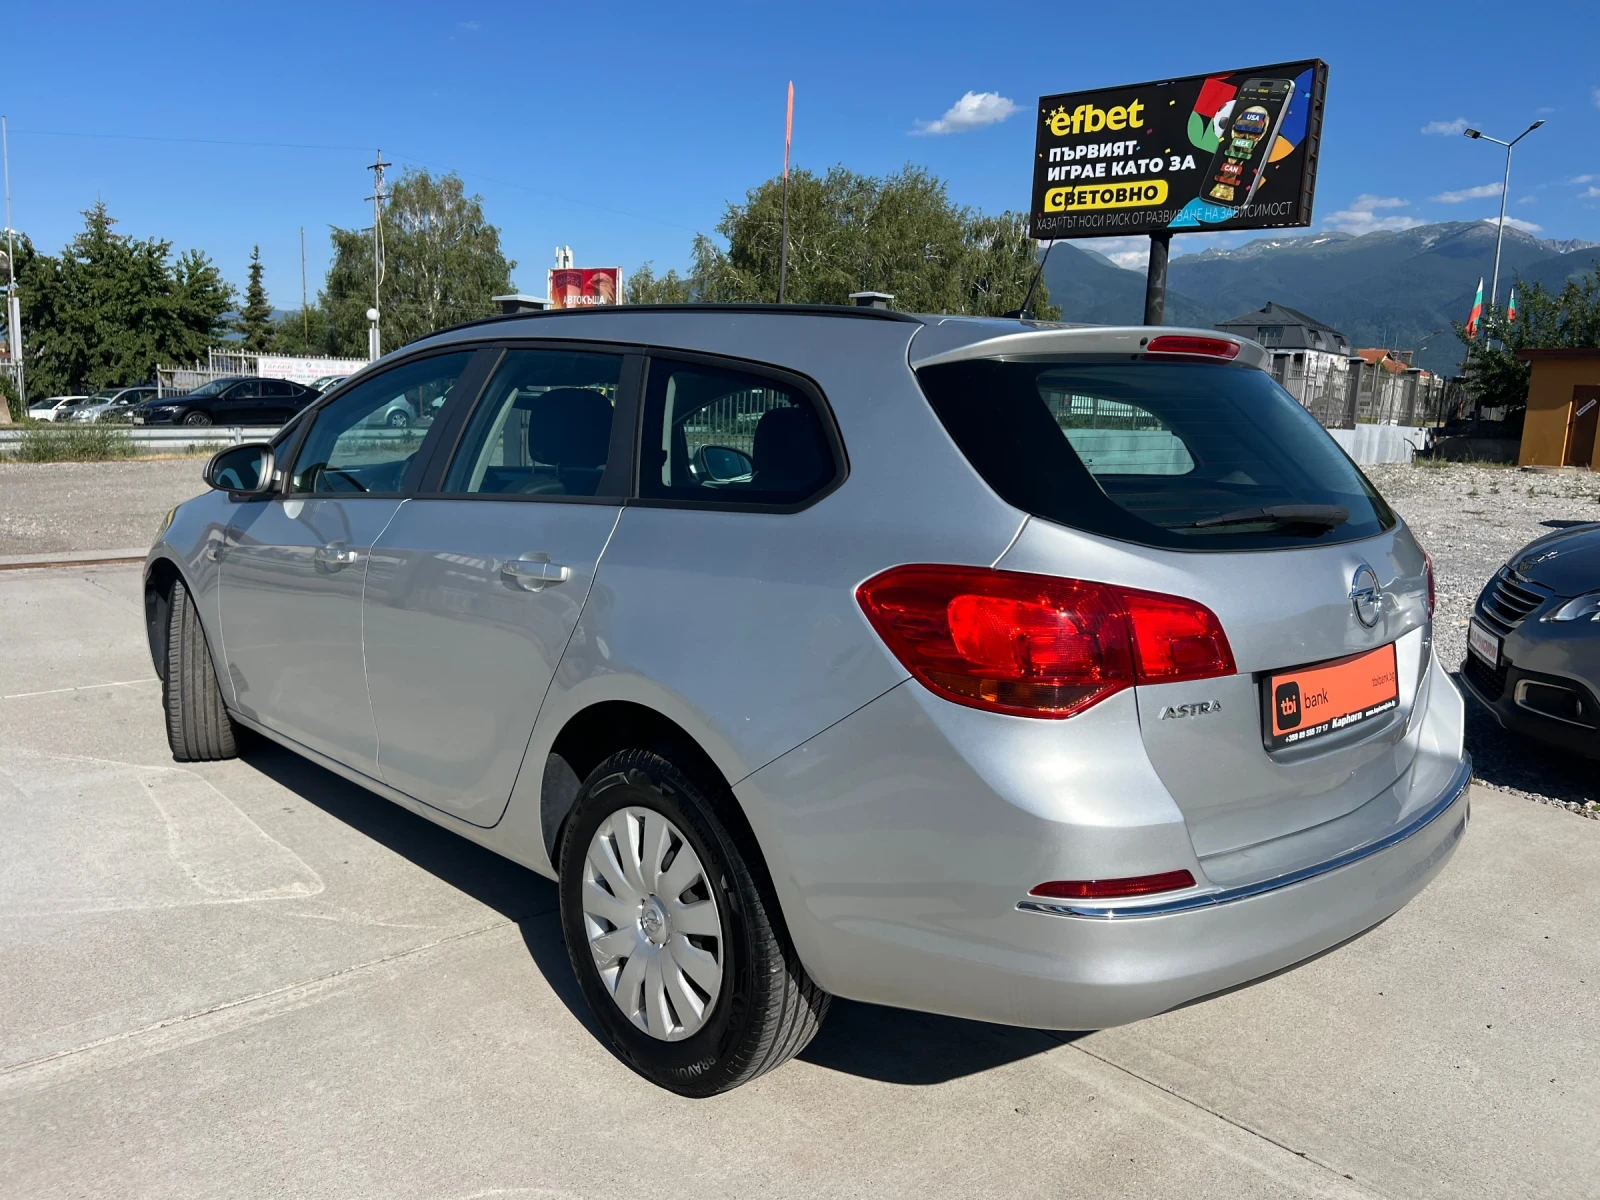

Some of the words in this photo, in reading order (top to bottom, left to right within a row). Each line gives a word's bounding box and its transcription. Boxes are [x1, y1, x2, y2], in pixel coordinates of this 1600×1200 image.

[1050, 97, 1145, 137] efbet
[1246, 113, 1260, 121] USA
[1048, 139, 1138, 163] ПЪРВИЯТ
[1235, 139, 1250, 148] MEX
[1047, 163, 1107, 182] ИГРАЕ
[1111, 157, 1164, 177] КАТО
[1168, 154, 1197, 171] ЗА
[1224, 164, 1239, 173] CAN
[1051, 185, 1159, 207] СВЕТОВНО
[1079, 214, 1104, 228] НОСИ
[1106, 212, 1130, 226] РИСК
[1131, 211, 1145, 225] ОТ
[1146, 207, 1203, 224] РАЗВИВАНЕ
[1204, 207, 1218, 220] НА
[1221, 201, 1293, 220] ЗАВИСИМОСТ
[562, 294, 606, 305] АВТОКЪЩА
[1157, 699, 1222, 721] ASTRA
[1280, 694, 1297, 716] tbi
[1303, 687, 1329, 710] bank
[1331, 711, 1363, 729] Kaphorn
